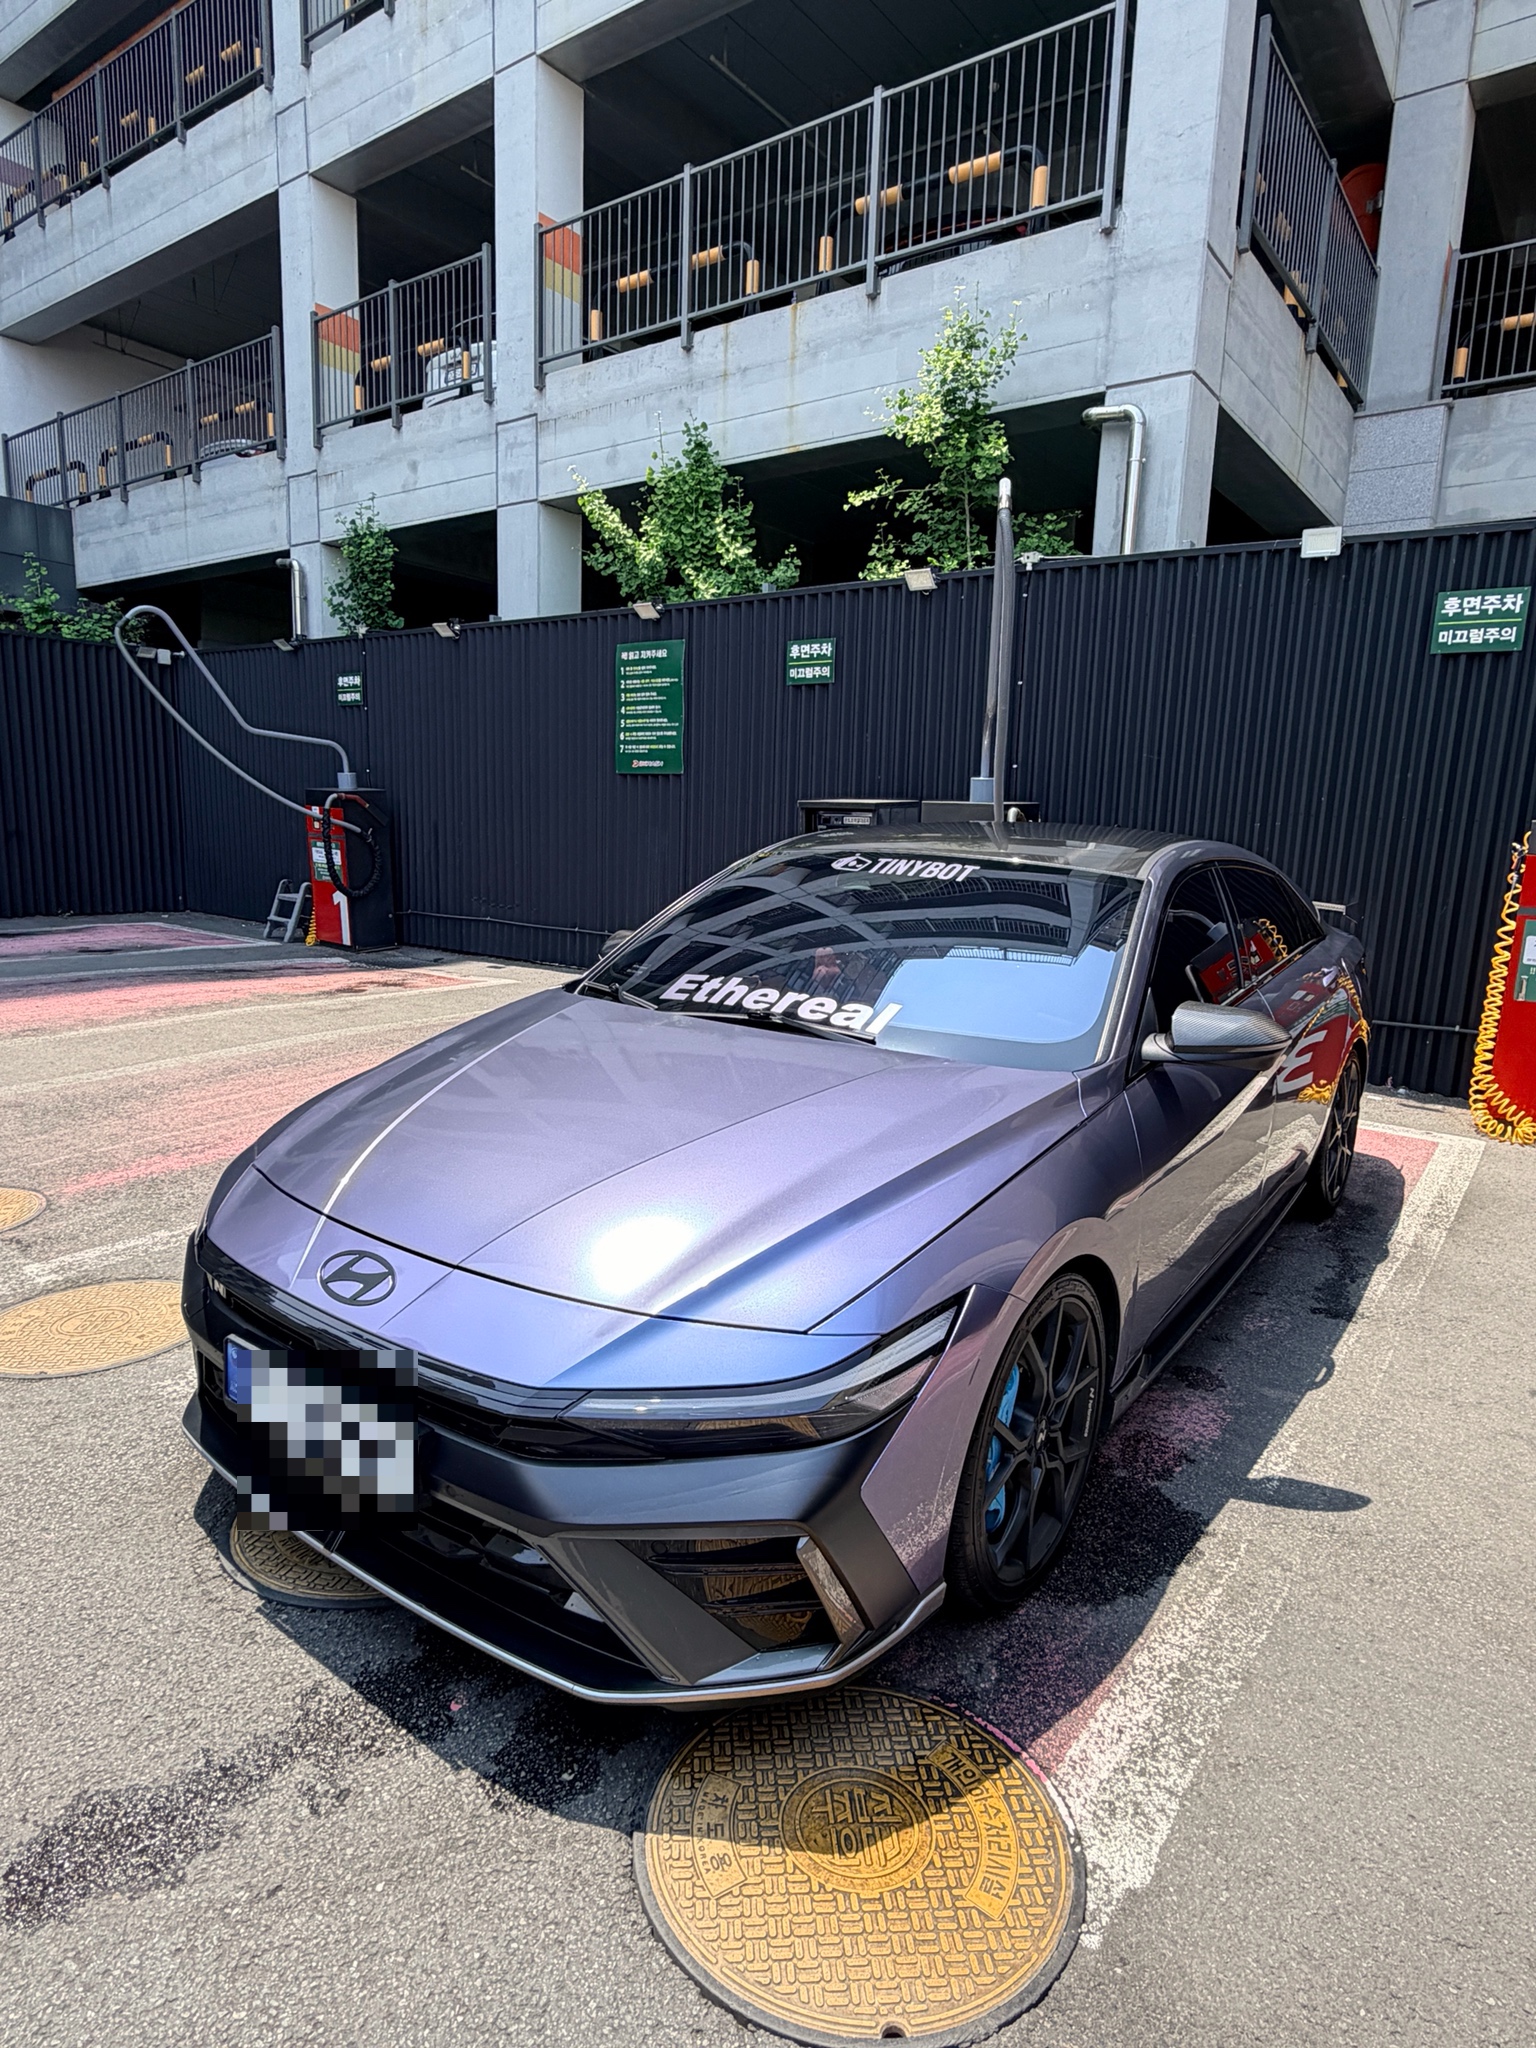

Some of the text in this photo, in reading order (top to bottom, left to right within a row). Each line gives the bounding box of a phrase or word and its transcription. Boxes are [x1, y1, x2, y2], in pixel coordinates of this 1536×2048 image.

[1440, 593, 1524, 617] 후면주차
[1438, 626, 1517, 646] 미끄럼주의
[789, 642, 833, 659] 후면주차
[789, 665, 830, 680] 미끄럼주의
[868, 857, 981, 882] TINYBOT
[332, 890, 352, 946] 1
[659, 973, 903, 1035] Ethereal
[942, 1752, 1012, 1900] 개인하수처리시설
